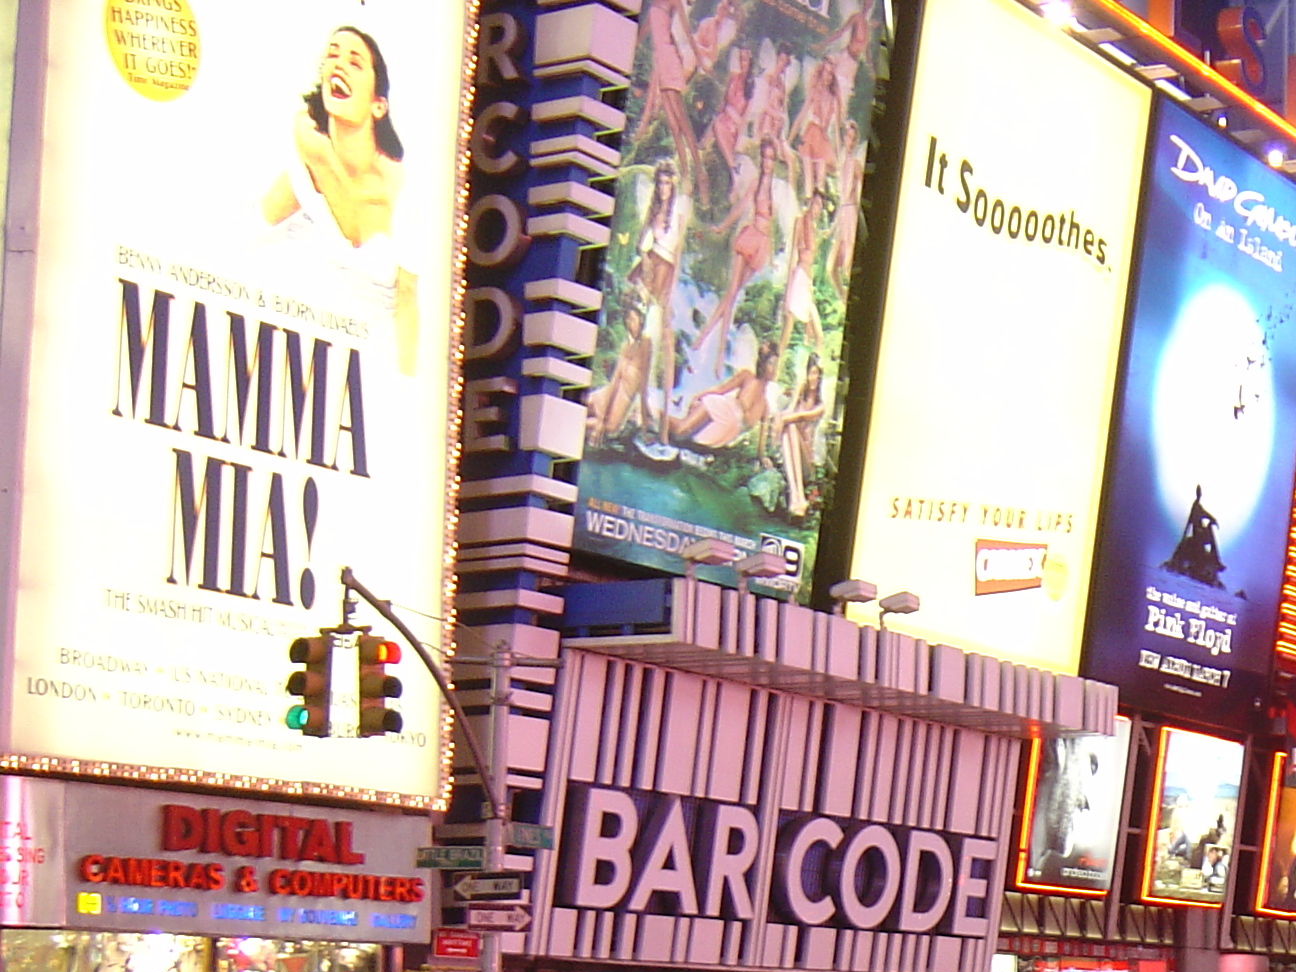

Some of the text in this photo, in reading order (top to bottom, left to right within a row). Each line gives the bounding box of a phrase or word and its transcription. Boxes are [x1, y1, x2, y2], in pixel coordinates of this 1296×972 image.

[111, 6, 197, 37] HAPPINESS
[114, 29, 197, 59] WHEREVER
[124, 53, 136, 70] IT
[925, 136, 948, 195] It
[1238, 228, 1283, 273] Island
[112, 277, 371, 478] MAMMA
[167, 447, 318, 610] MIA!
[586, 510, 698, 557] WEDNESDA
[891, 497, 1073, 533] SATISFY YOUR LIPS
[107, 588, 130, 611] THE
[138, 595, 186, 619] SMASH
[1144, 605, 1232, 656] Pink Floyd
[60, 648, 148, 675] BROADWAY
[27, 677, 96, 701] LONDON
[121, 691, 195, 716] TORONTO
[218, 708, 272, 727] SYDNEY
[163, 804, 365, 865] DIGITAL
[80, 854, 426, 903] CAMERAS & COMPUTERS
[576, 788, 999, 936] BAR CODE
[494, 880, 512, 891] WAY
[508, 911, 525, 922] WAY
